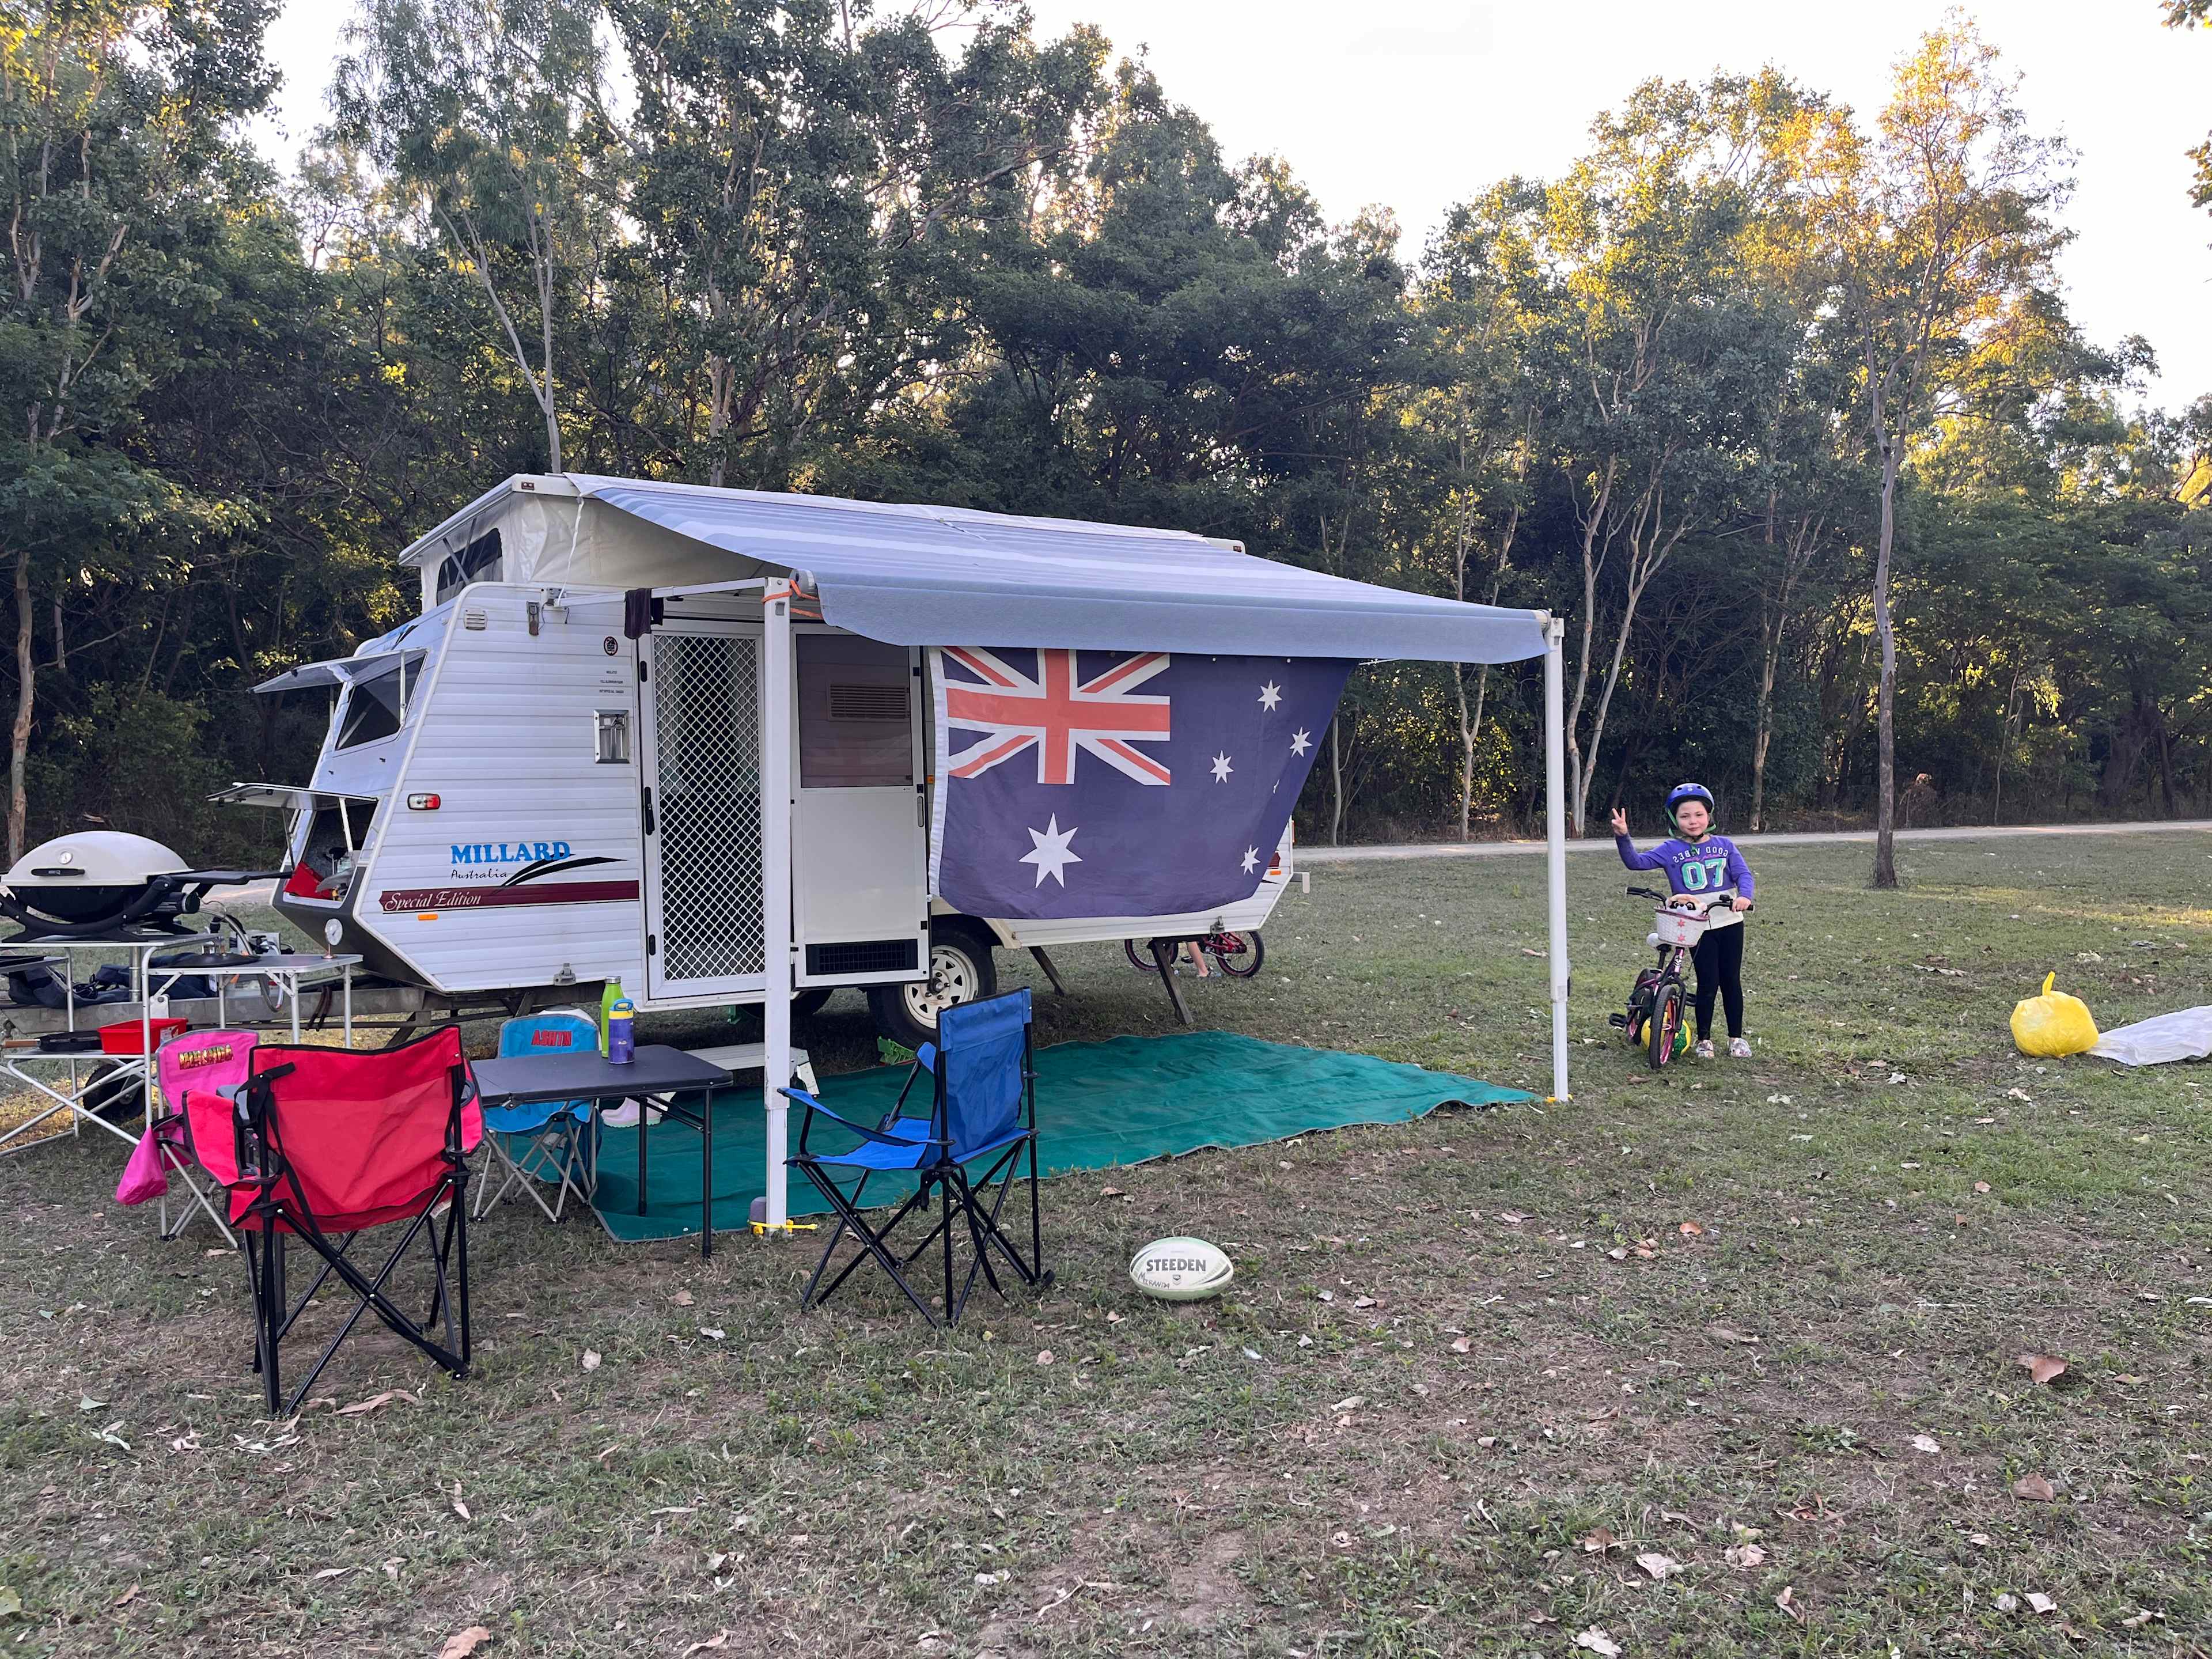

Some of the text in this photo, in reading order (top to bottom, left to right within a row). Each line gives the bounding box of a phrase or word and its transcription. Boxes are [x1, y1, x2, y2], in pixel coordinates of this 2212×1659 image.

[450, 842, 570, 864] MILLARD
[450, 869, 507, 879] Australia
[1681, 858, 1726, 891] 07
[385, 891, 482, 911] Special Edition
[1146, 1258, 1206, 1272] STEEDEN
